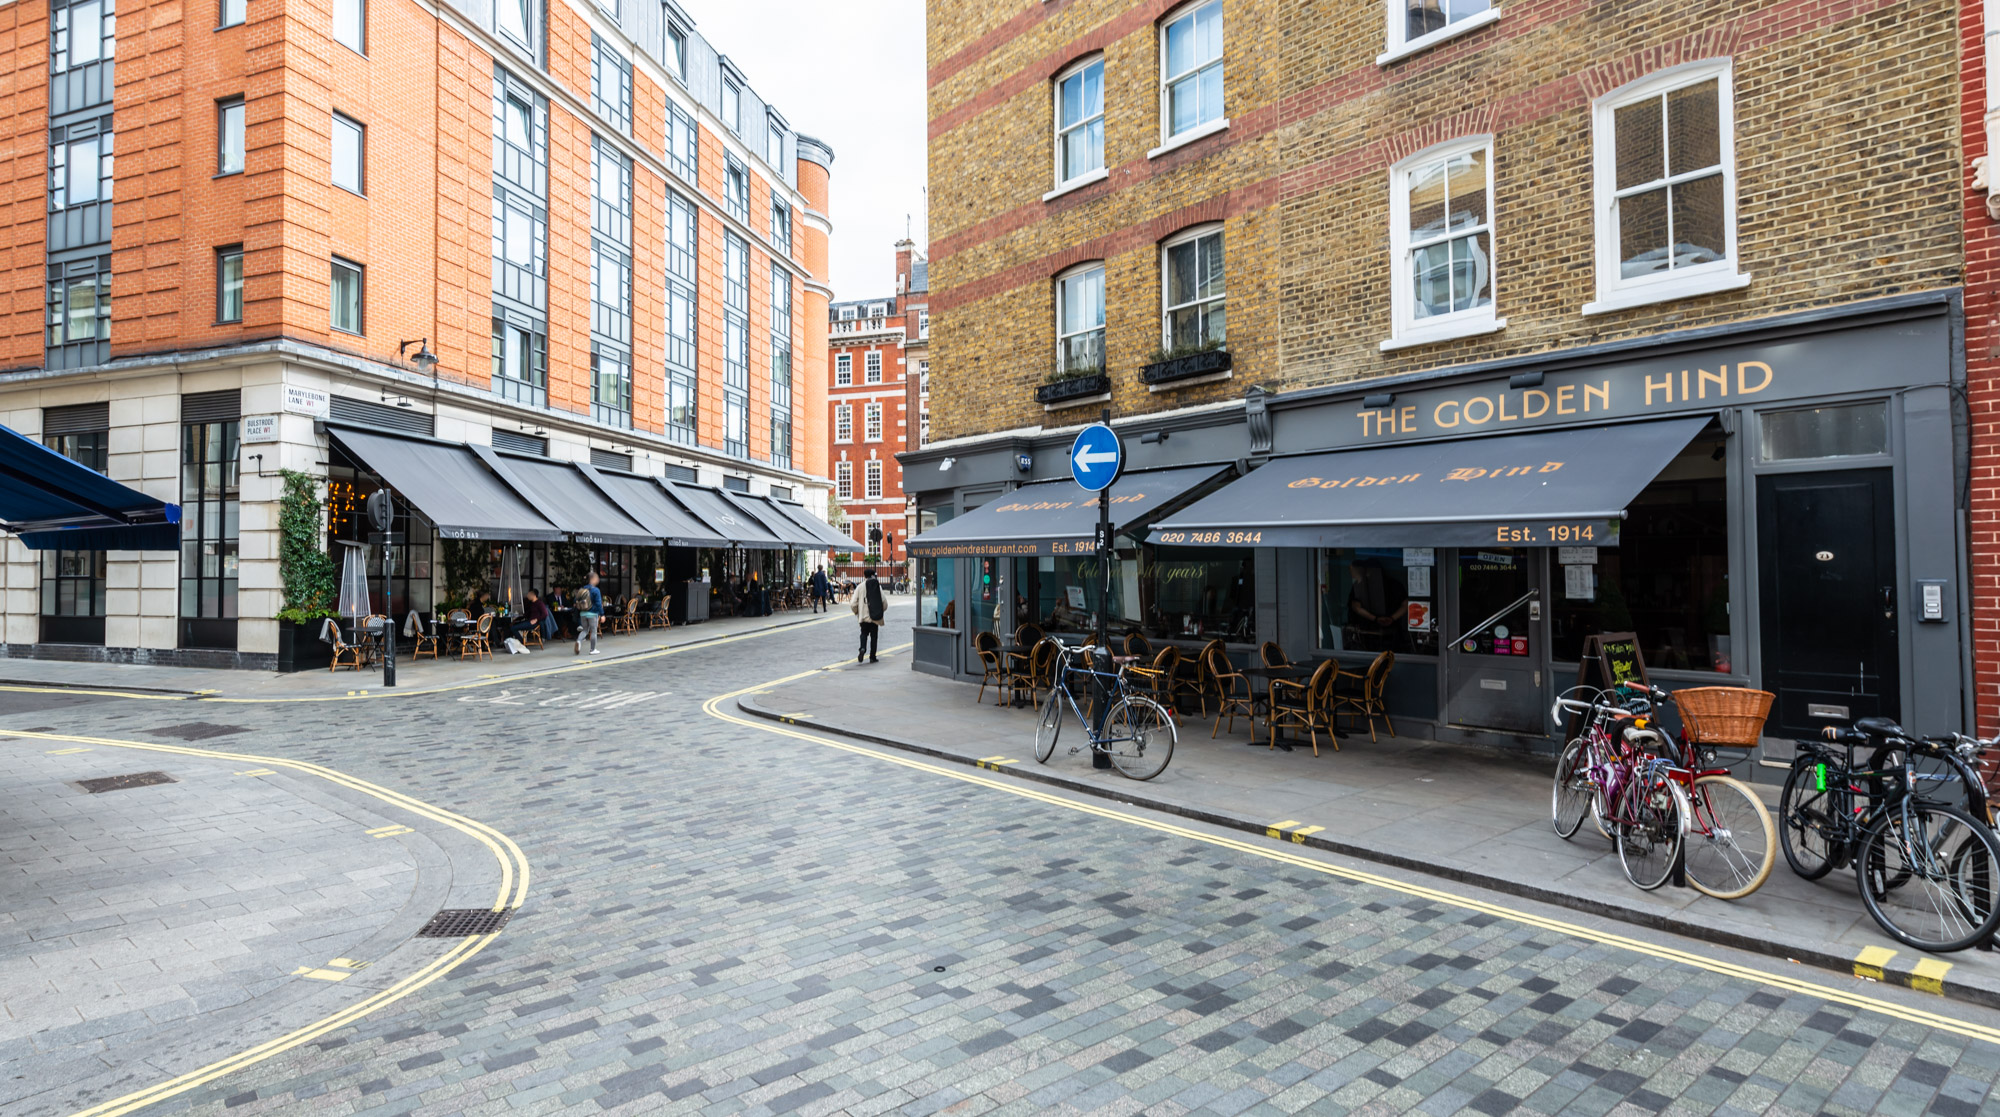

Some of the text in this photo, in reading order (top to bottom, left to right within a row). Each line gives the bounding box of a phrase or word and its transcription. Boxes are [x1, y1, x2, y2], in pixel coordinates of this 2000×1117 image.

[288, 388, 326, 402] MARYLEBONE
[288, 397, 303, 406] LANE
[1357, 361, 1773, 437] THE GOLDEN HIND
[247, 418, 274, 427] BULSTRODE
[247, 427, 261, 435] PLACE
[1287, 461, 1566, 489] Golden Hind
[996, 501, 1073, 512] Golden
[1160, 531, 1262, 544] 020 7486 3644
[1497, 525, 1594, 542] Est. 1914
[912, 541, 1095, 557] www.goldenhindrestaurant.com Est. 1914
[1482, 553, 1506, 562] OPEN
[1164, 564, 1204, 584] years
